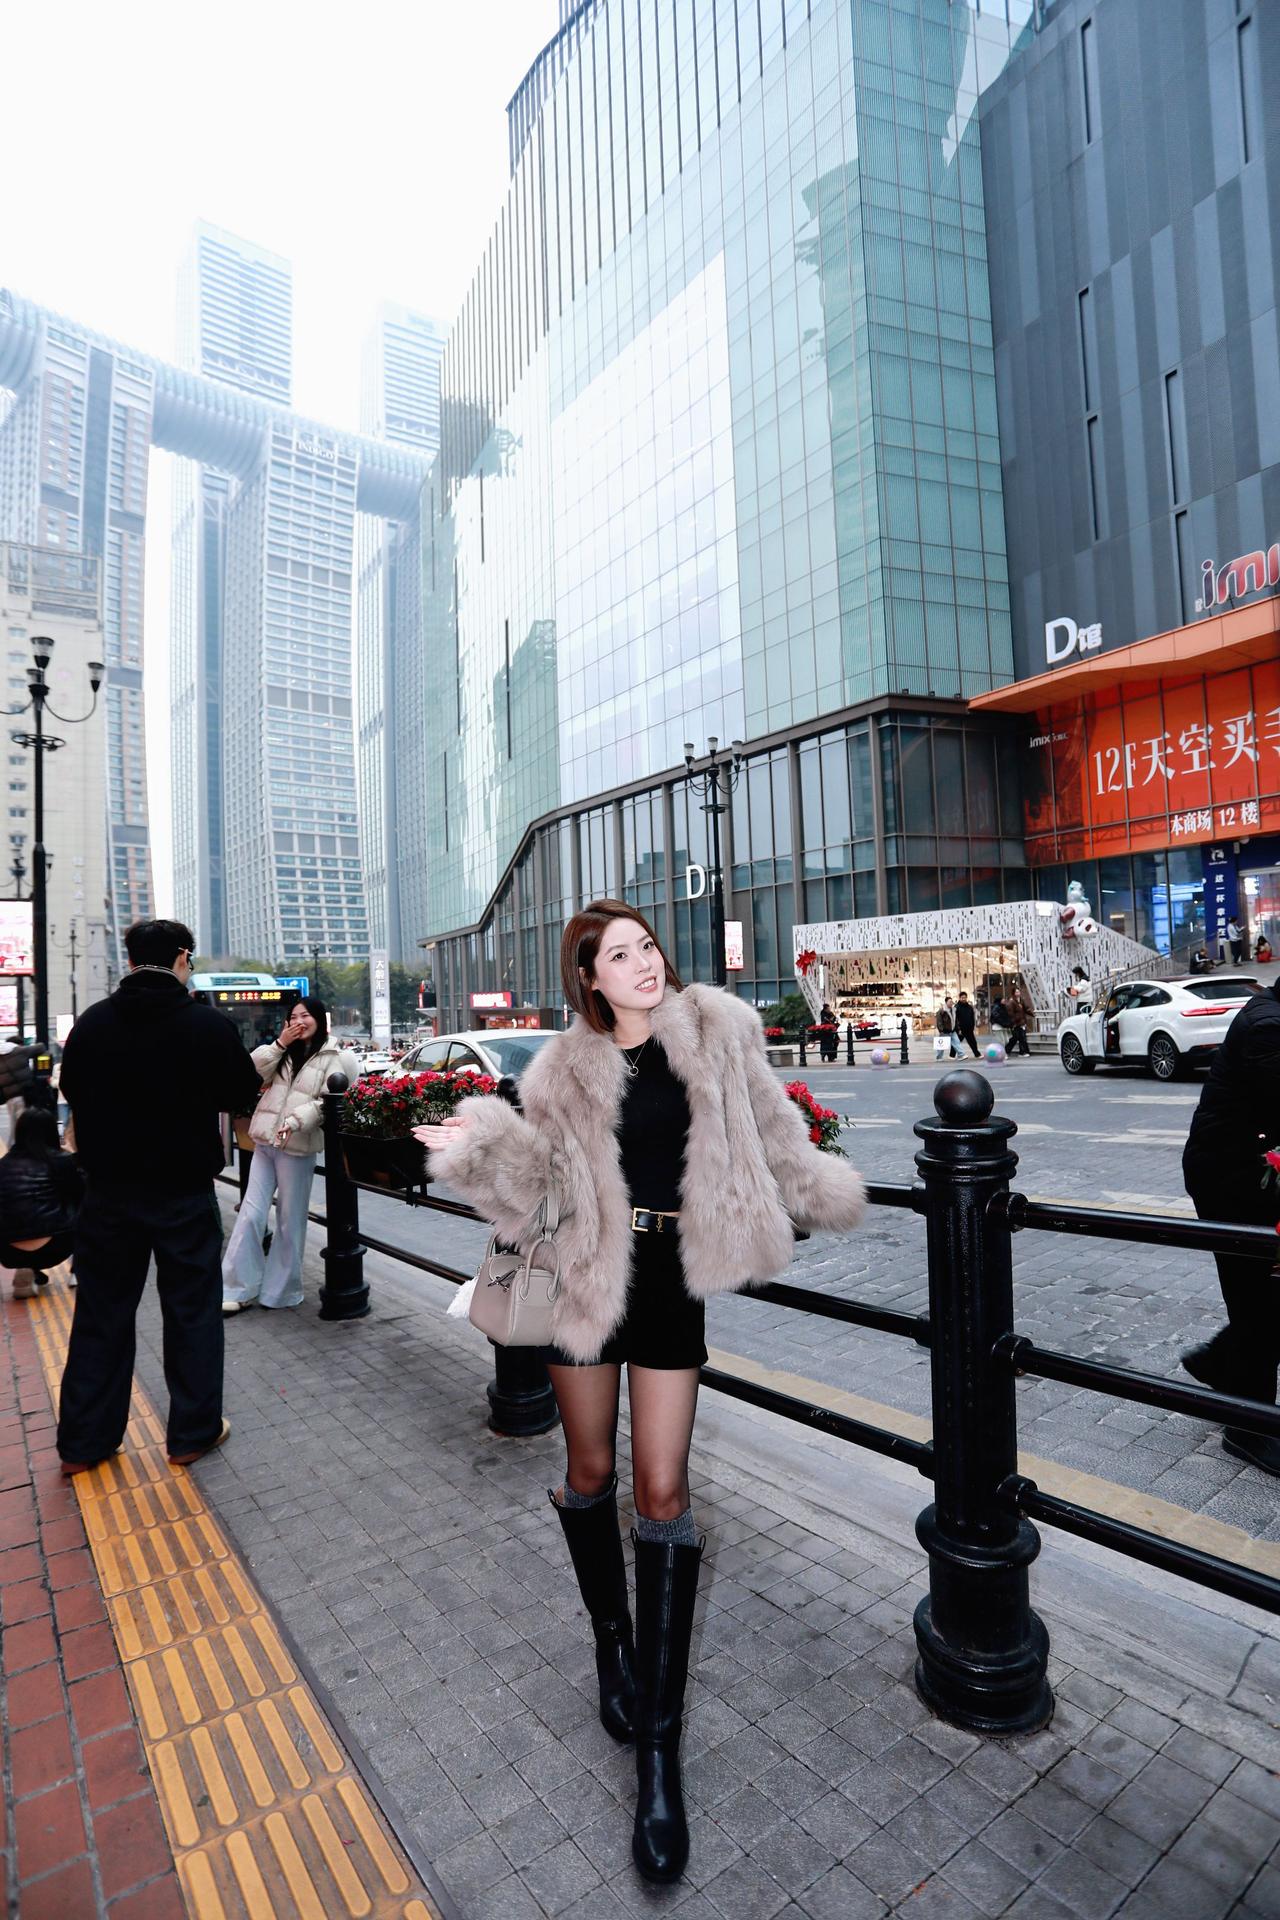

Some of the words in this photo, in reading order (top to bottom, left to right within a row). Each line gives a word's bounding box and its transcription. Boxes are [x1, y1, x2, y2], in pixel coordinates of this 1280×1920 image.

[1171, 810, 1212, 836] 本商场
[1219, 807, 1235, 827] 12
